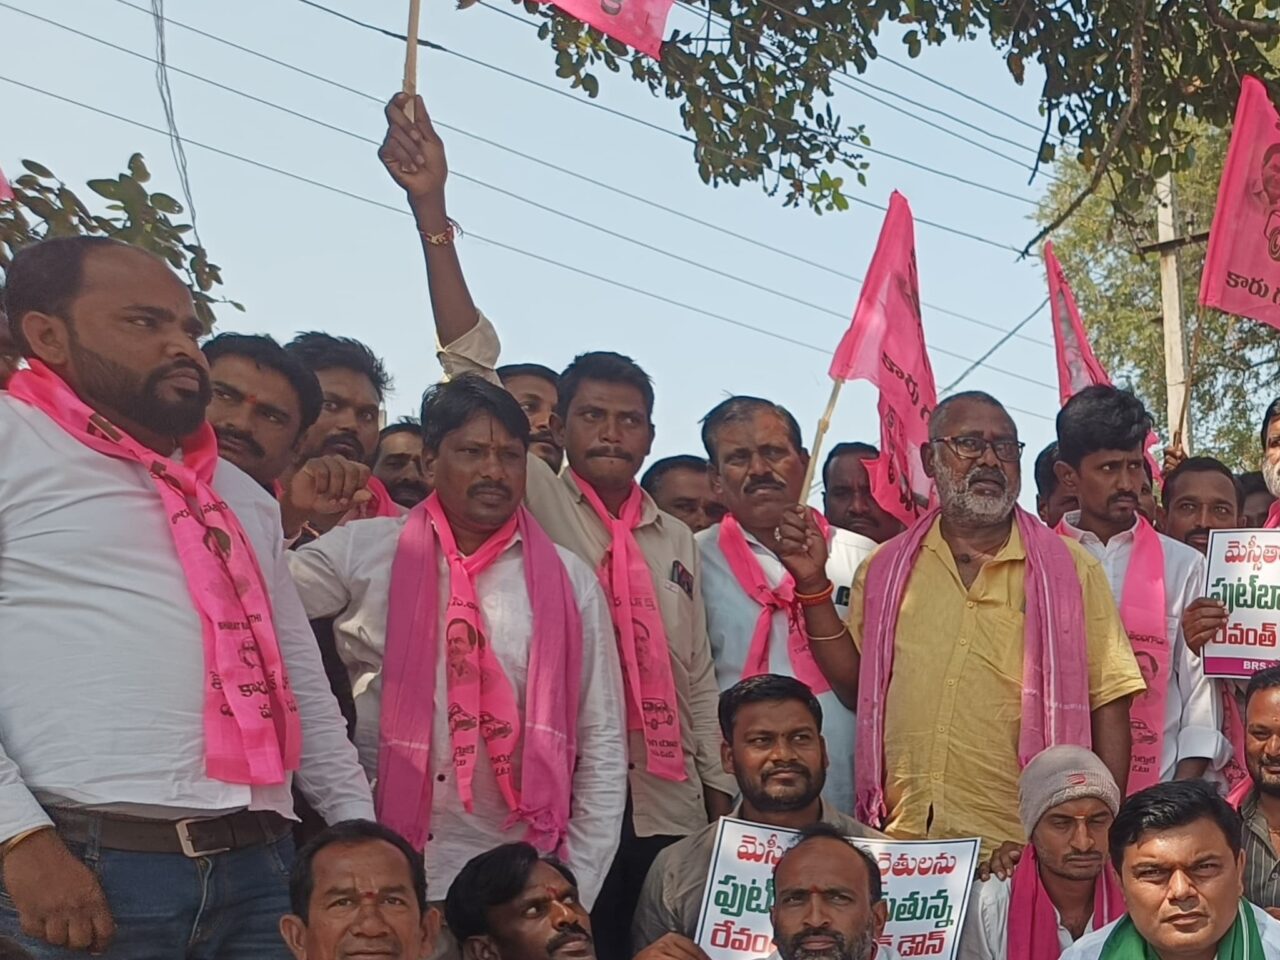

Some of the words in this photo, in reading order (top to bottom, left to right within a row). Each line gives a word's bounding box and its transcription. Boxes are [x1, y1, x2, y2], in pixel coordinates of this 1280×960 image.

[1226, 271, 1269, 298] కారు
[1243, 661, 1266, 669] BRS
[710, 920, 777, 952] రేవం
[898, 931, 946, 956] డౌన్
